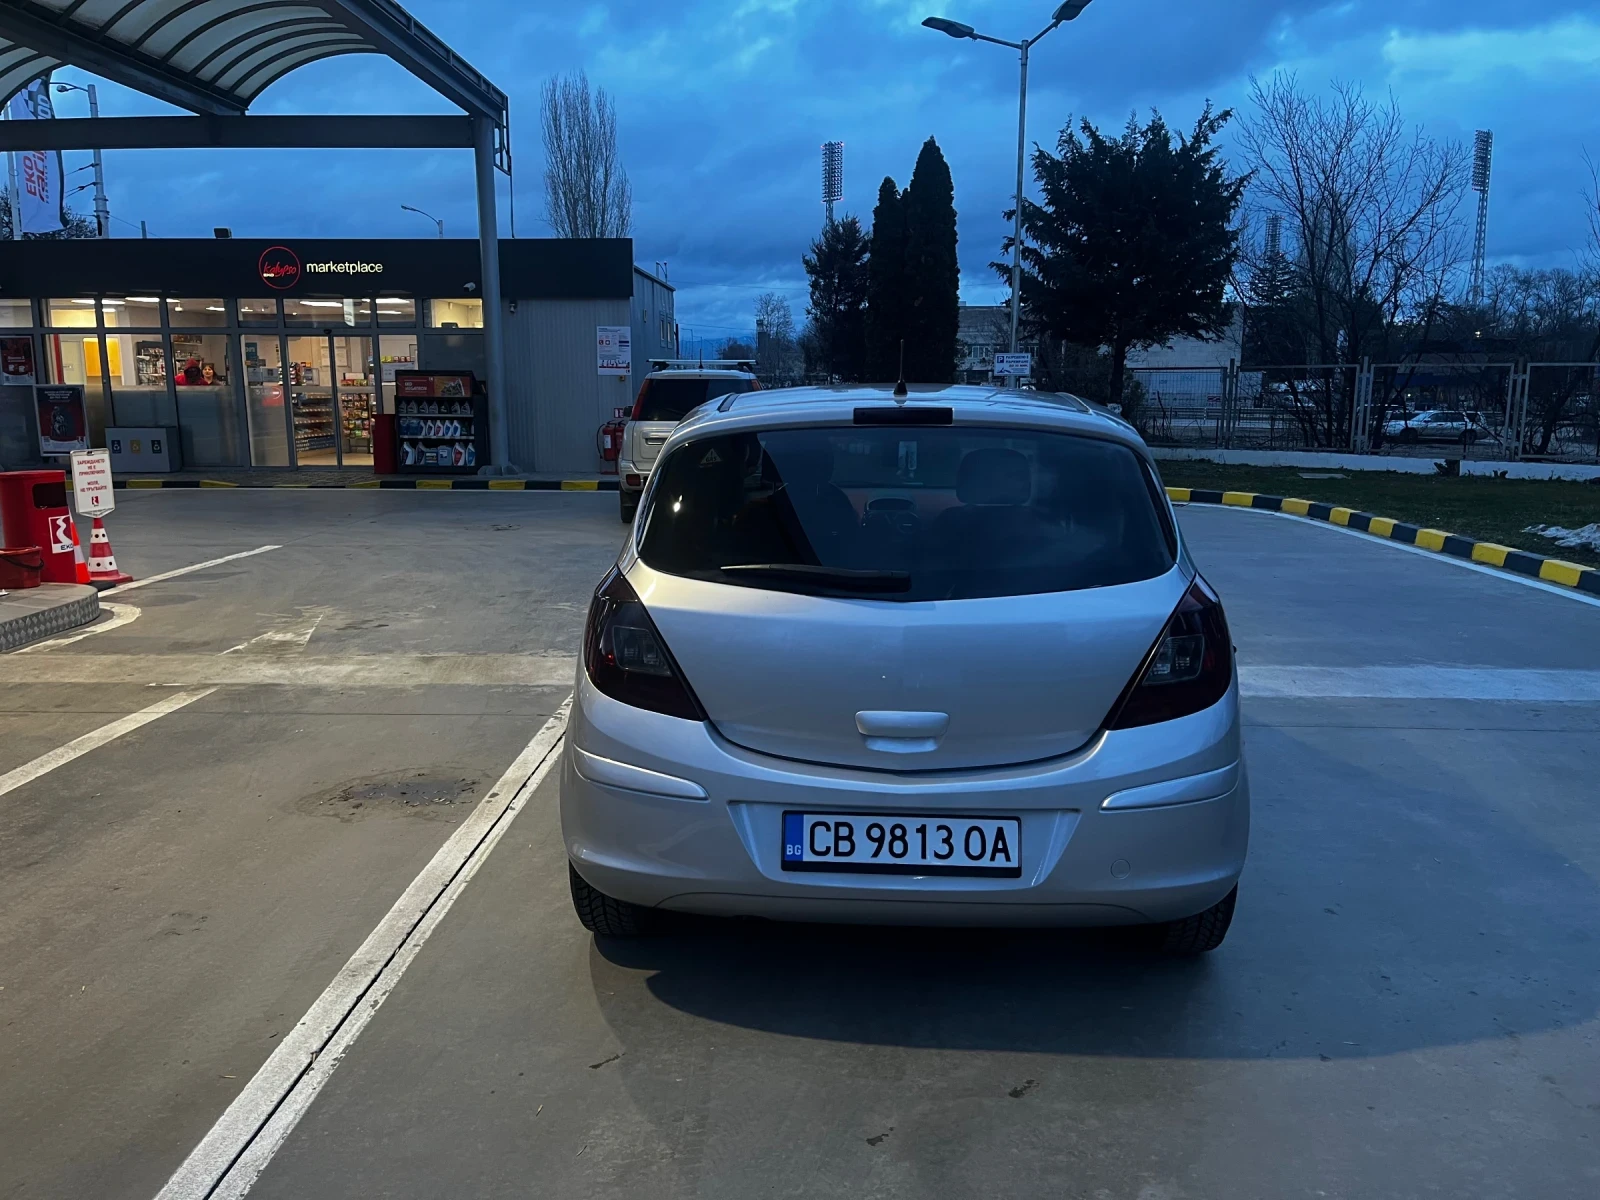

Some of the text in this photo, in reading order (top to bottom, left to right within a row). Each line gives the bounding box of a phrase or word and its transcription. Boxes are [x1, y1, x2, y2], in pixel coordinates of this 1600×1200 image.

[23, 155, 37, 197] EKO
[306, 260, 384, 275] marketplace
[786, 844, 802, 855] BG
[809, 820, 856, 857] CB
[866, 822, 954, 860] 9813
